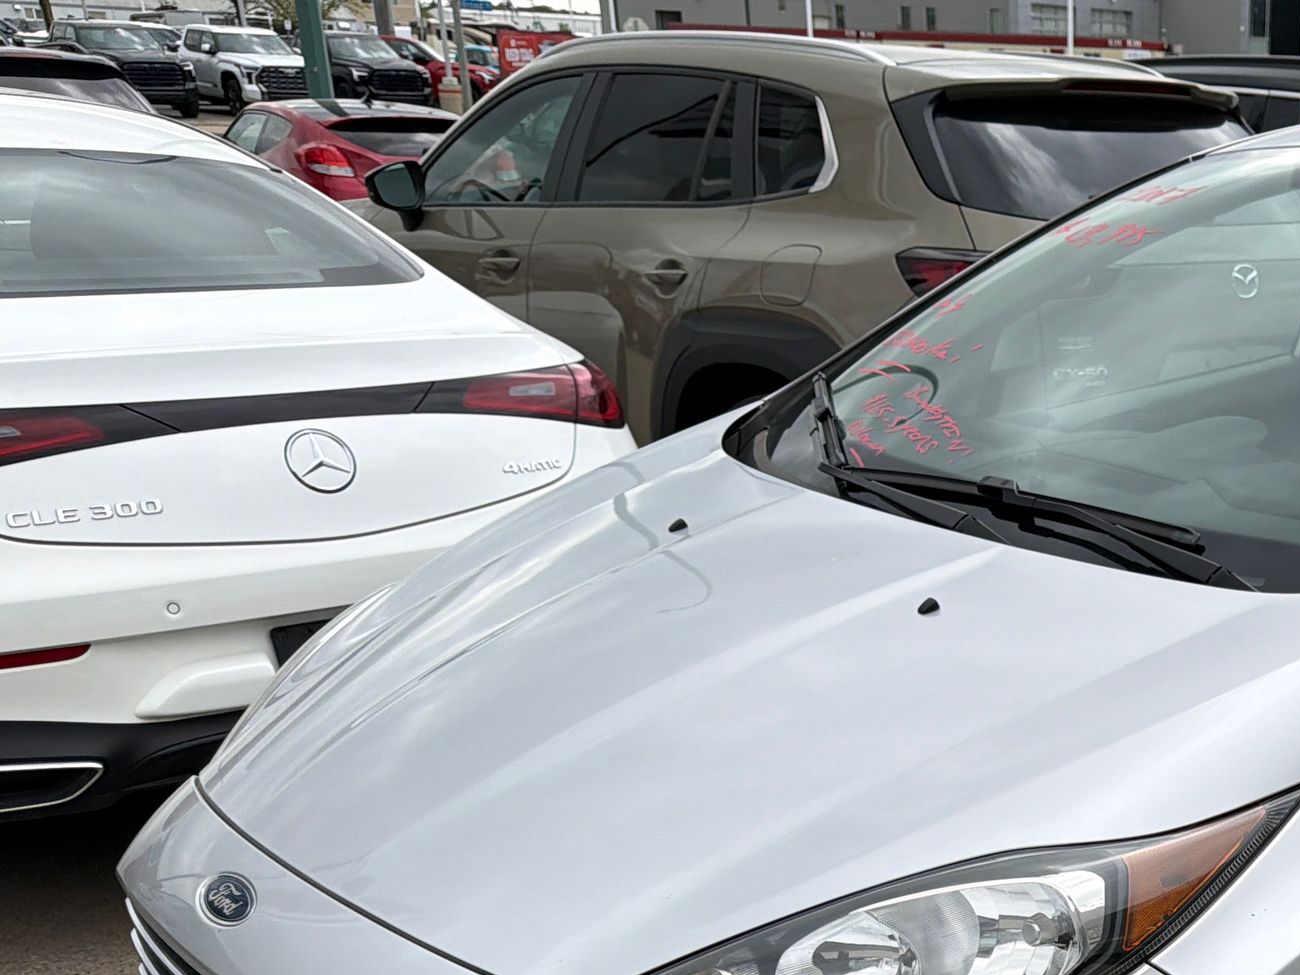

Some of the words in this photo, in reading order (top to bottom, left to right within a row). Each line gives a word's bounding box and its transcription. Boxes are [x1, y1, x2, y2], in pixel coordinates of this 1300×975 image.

[502, 459, 562, 475] 4MATIC
[6, 507, 81, 528] CLE
[89, 498, 163, 521] 300
[208, 882, 244, 916] Ford
